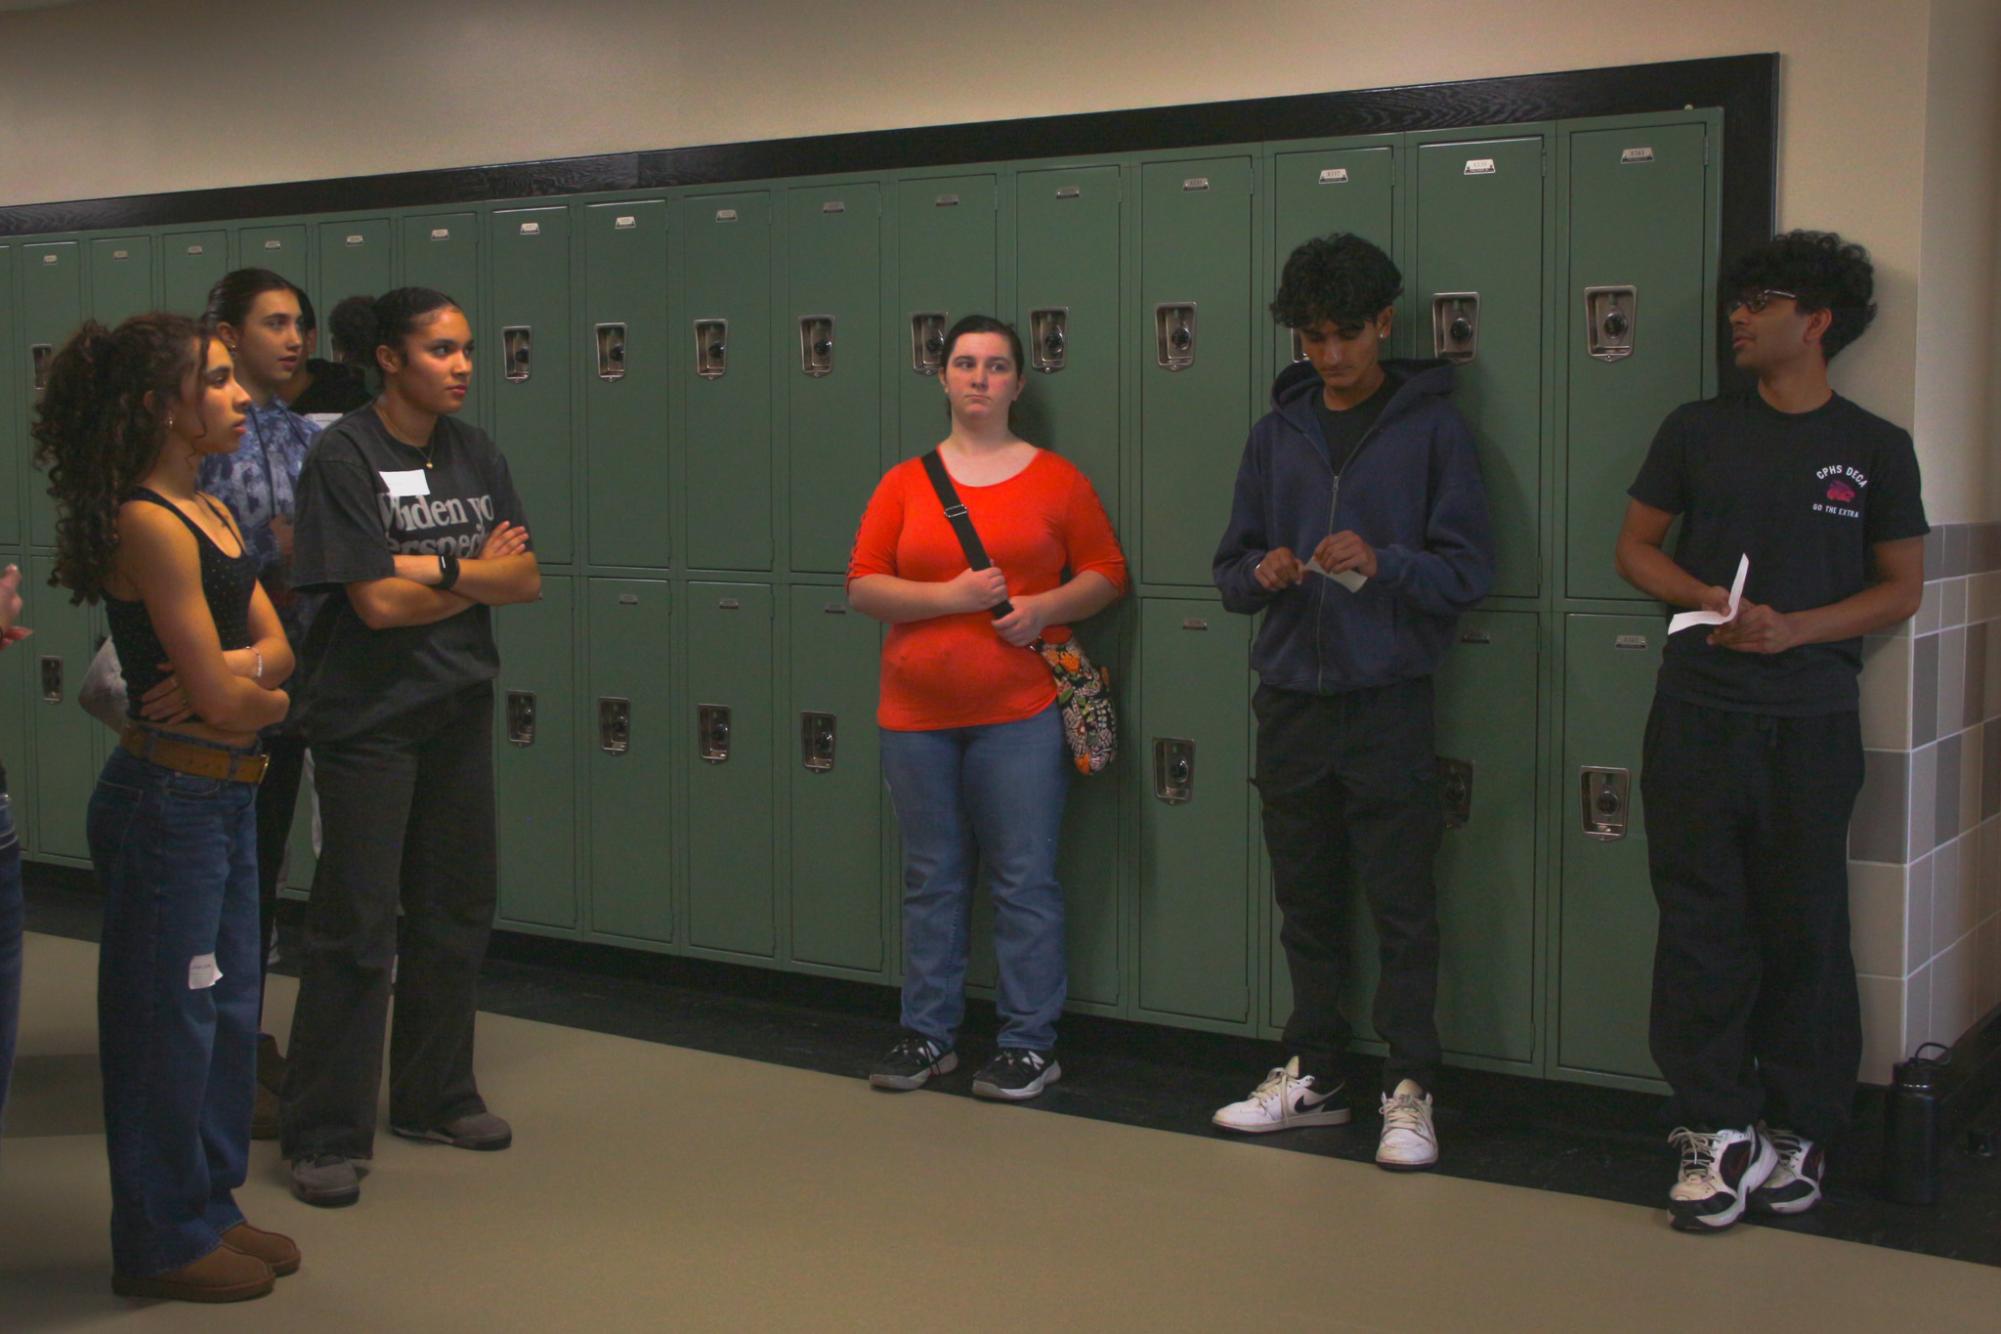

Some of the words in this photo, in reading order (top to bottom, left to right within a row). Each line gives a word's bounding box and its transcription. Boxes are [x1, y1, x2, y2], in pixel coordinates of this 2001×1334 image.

[1816, 464, 1843, 480] CPHS
[1845, 466, 1868, 488] DECA
[376, 492, 468, 532] Widen
[467, 494, 495, 532] yo
[1812, 503, 1823, 511] GO
[1825, 505, 1837, 514] THE
[1838, 508, 1860, 518] EXTRA
